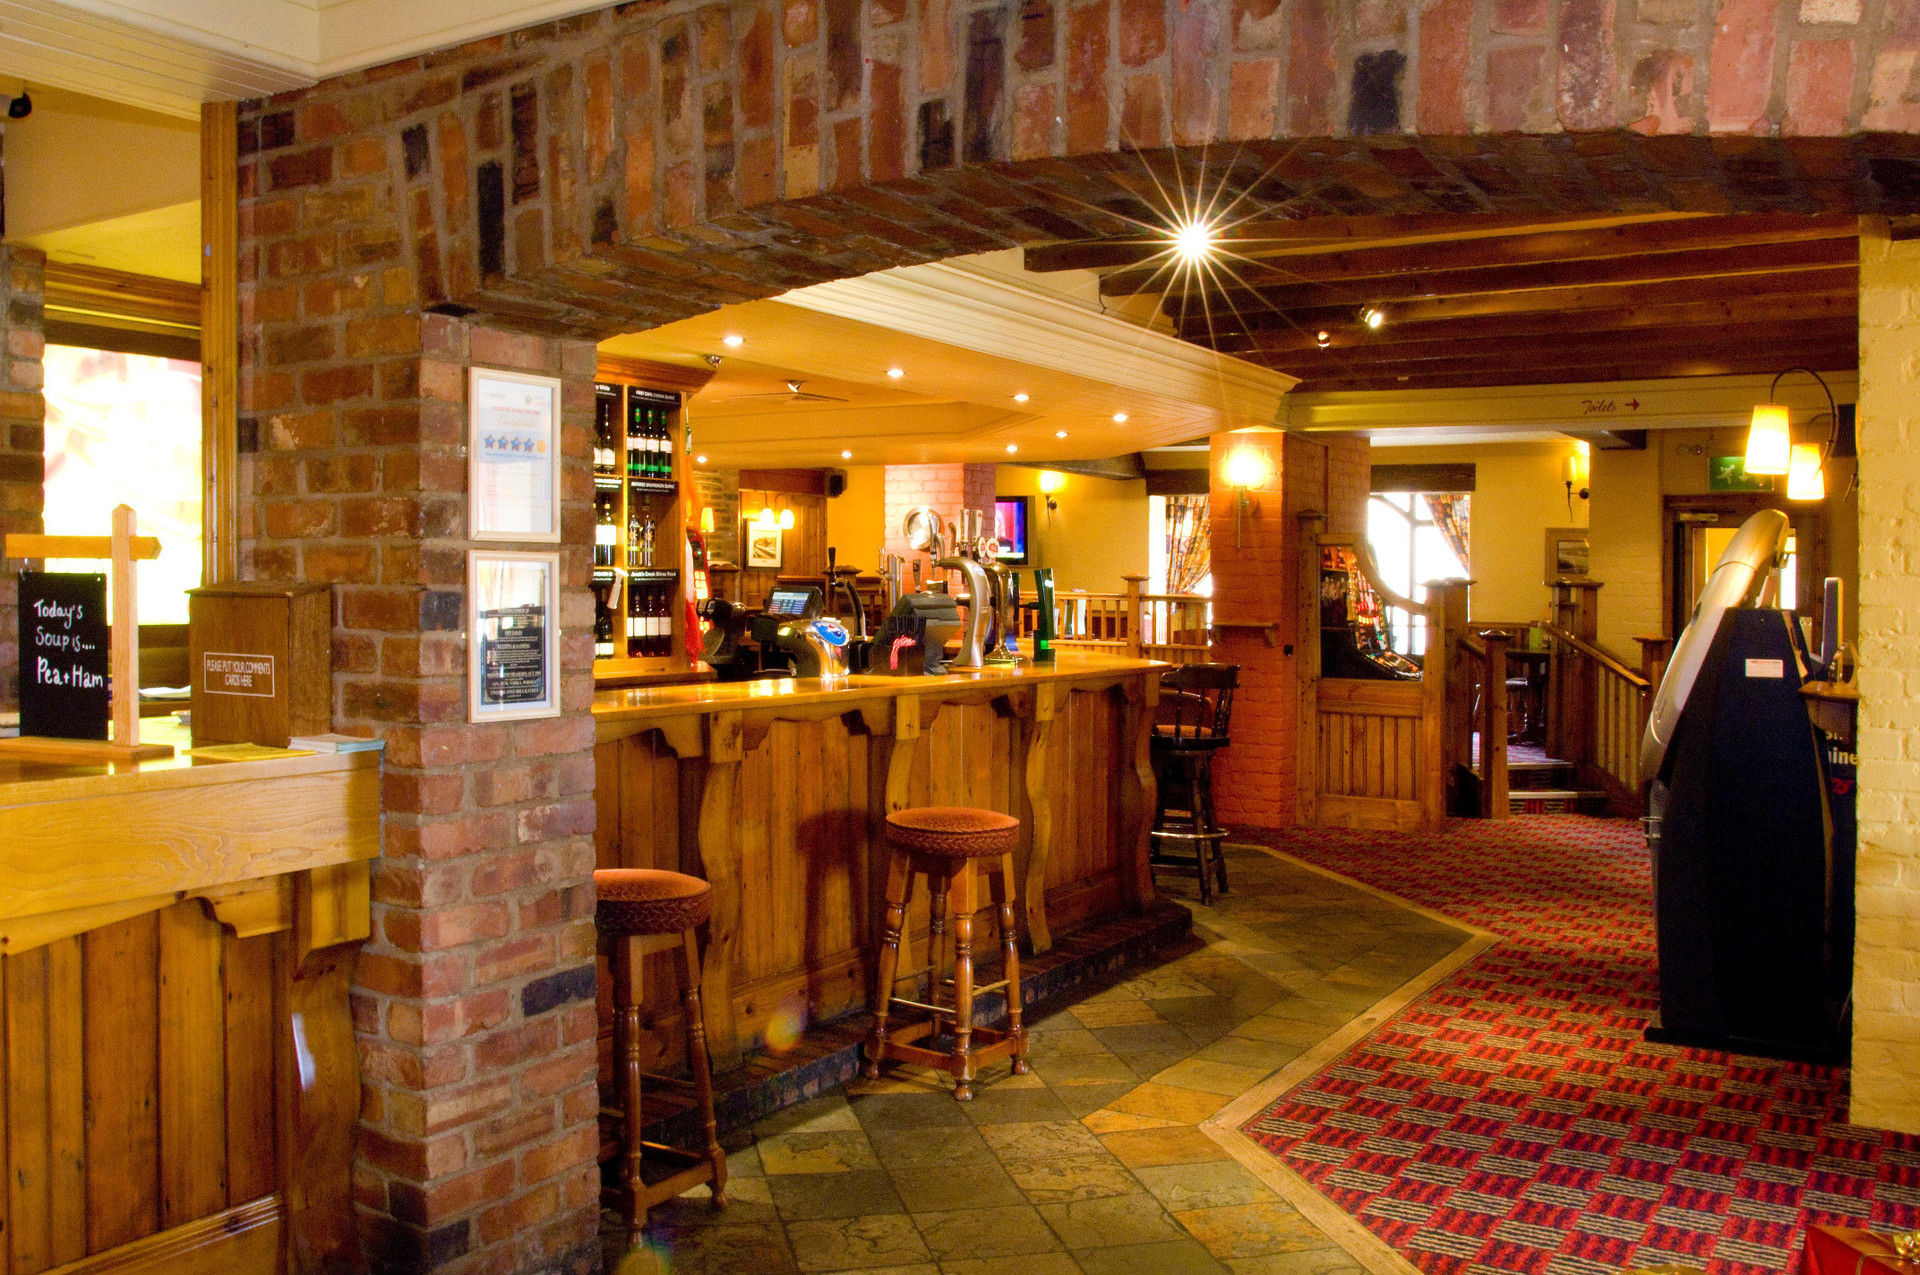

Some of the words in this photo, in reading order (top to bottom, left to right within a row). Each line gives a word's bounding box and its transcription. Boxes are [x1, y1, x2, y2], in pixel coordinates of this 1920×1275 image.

[1582, 400, 1616, 415] Toilets
[33, 599, 83, 629] Today's
[36, 625, 69, 652] Soup
[206, 659, 222, 672] PLEASE
[222, 660, 232, 672] PUT
[232, 661, 245, 673] YOUR
[245, 661, 271, 675] COMMENTS
[241, 675, 252, 687] HERE
